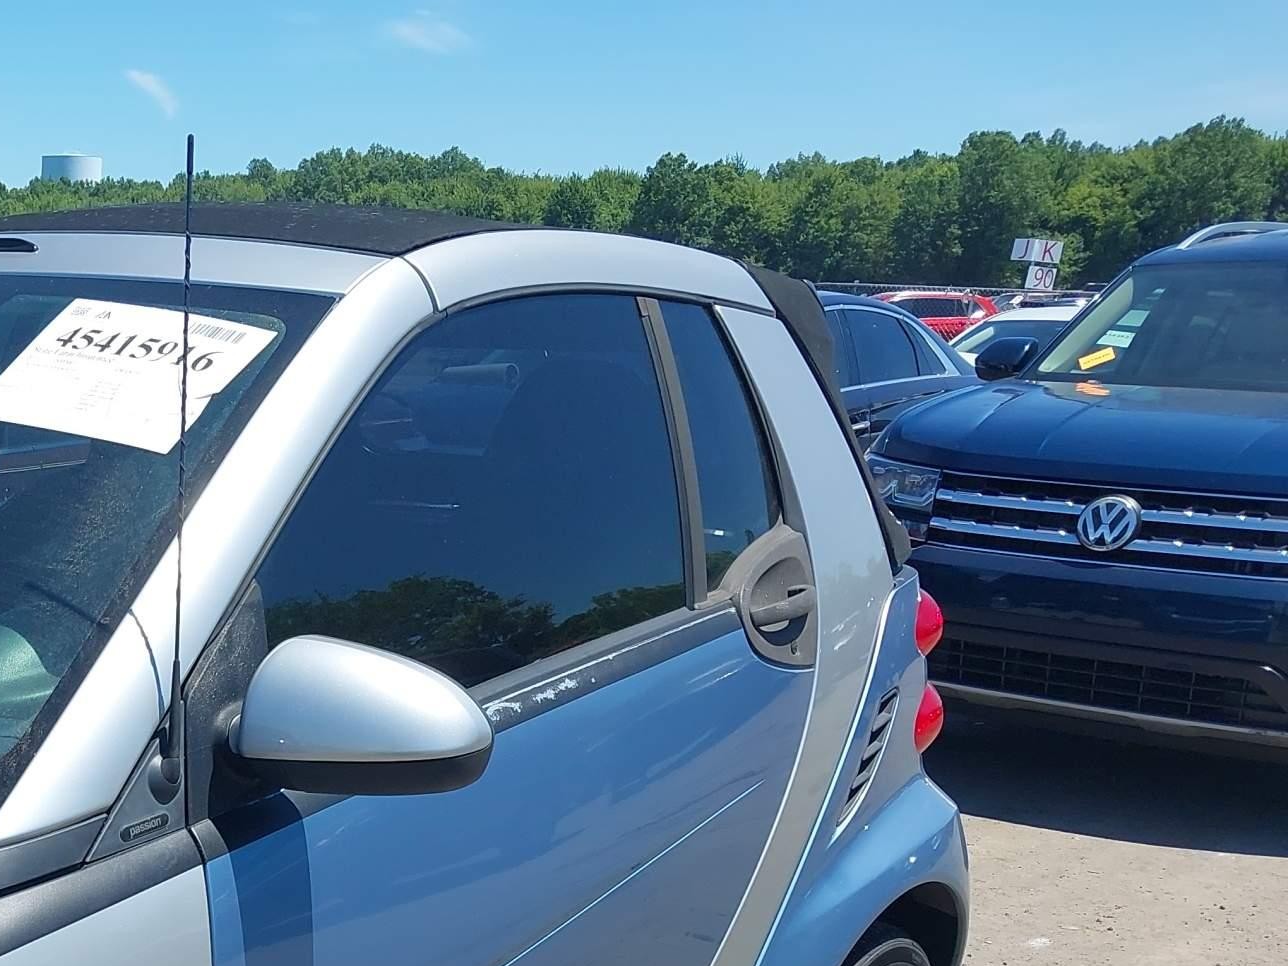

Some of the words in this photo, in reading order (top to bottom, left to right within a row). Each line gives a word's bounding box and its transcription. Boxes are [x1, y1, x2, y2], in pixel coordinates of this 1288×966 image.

[1017, 239, 1030, 259] J
[1042, 241, 1058, 262] K
[1032, 268, 1054, 289] 90
[55, 326, 224, 373] 45415916
[129, 817, 162, 839] passion
